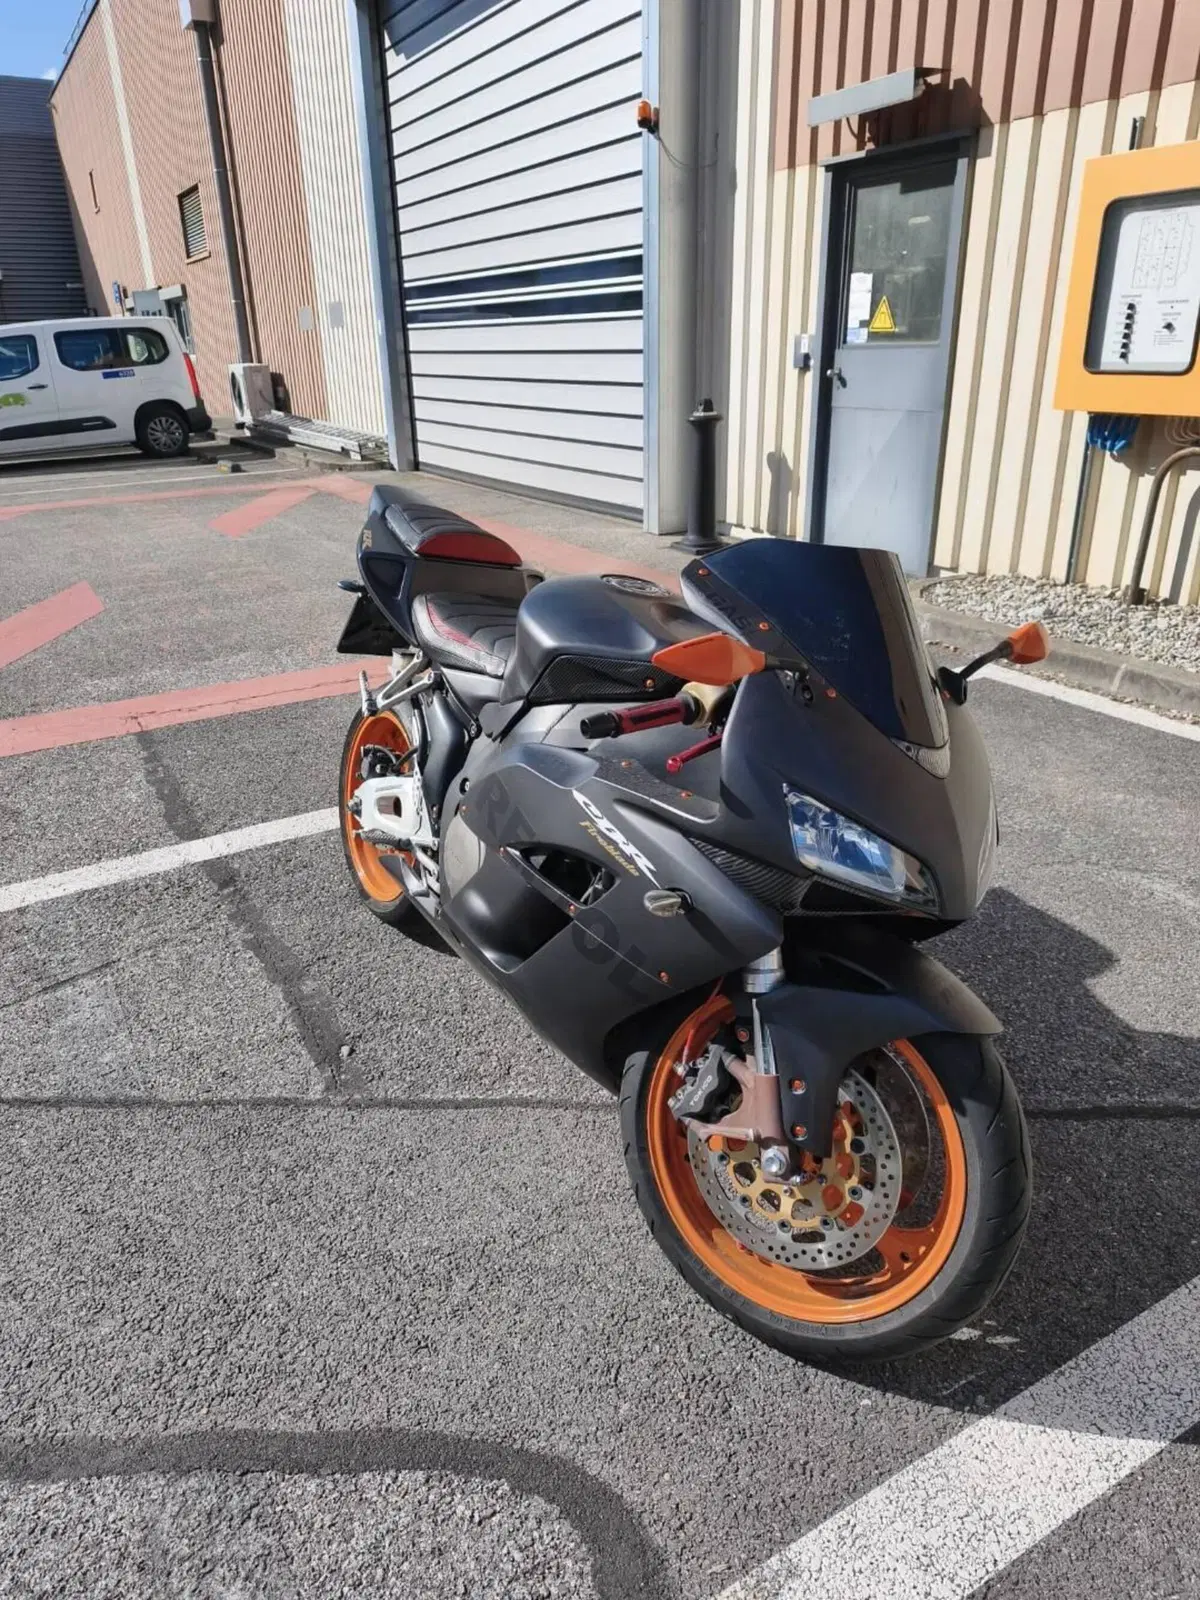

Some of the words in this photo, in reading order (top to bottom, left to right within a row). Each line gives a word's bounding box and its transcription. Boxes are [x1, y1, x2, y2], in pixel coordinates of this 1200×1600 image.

[571, 790, 660, 888] CBR
[578, 820, 640, 878] Fireblade
[472, 775, 649, 997] REOL
[689, 1075, 711, 1106] TOKICO
